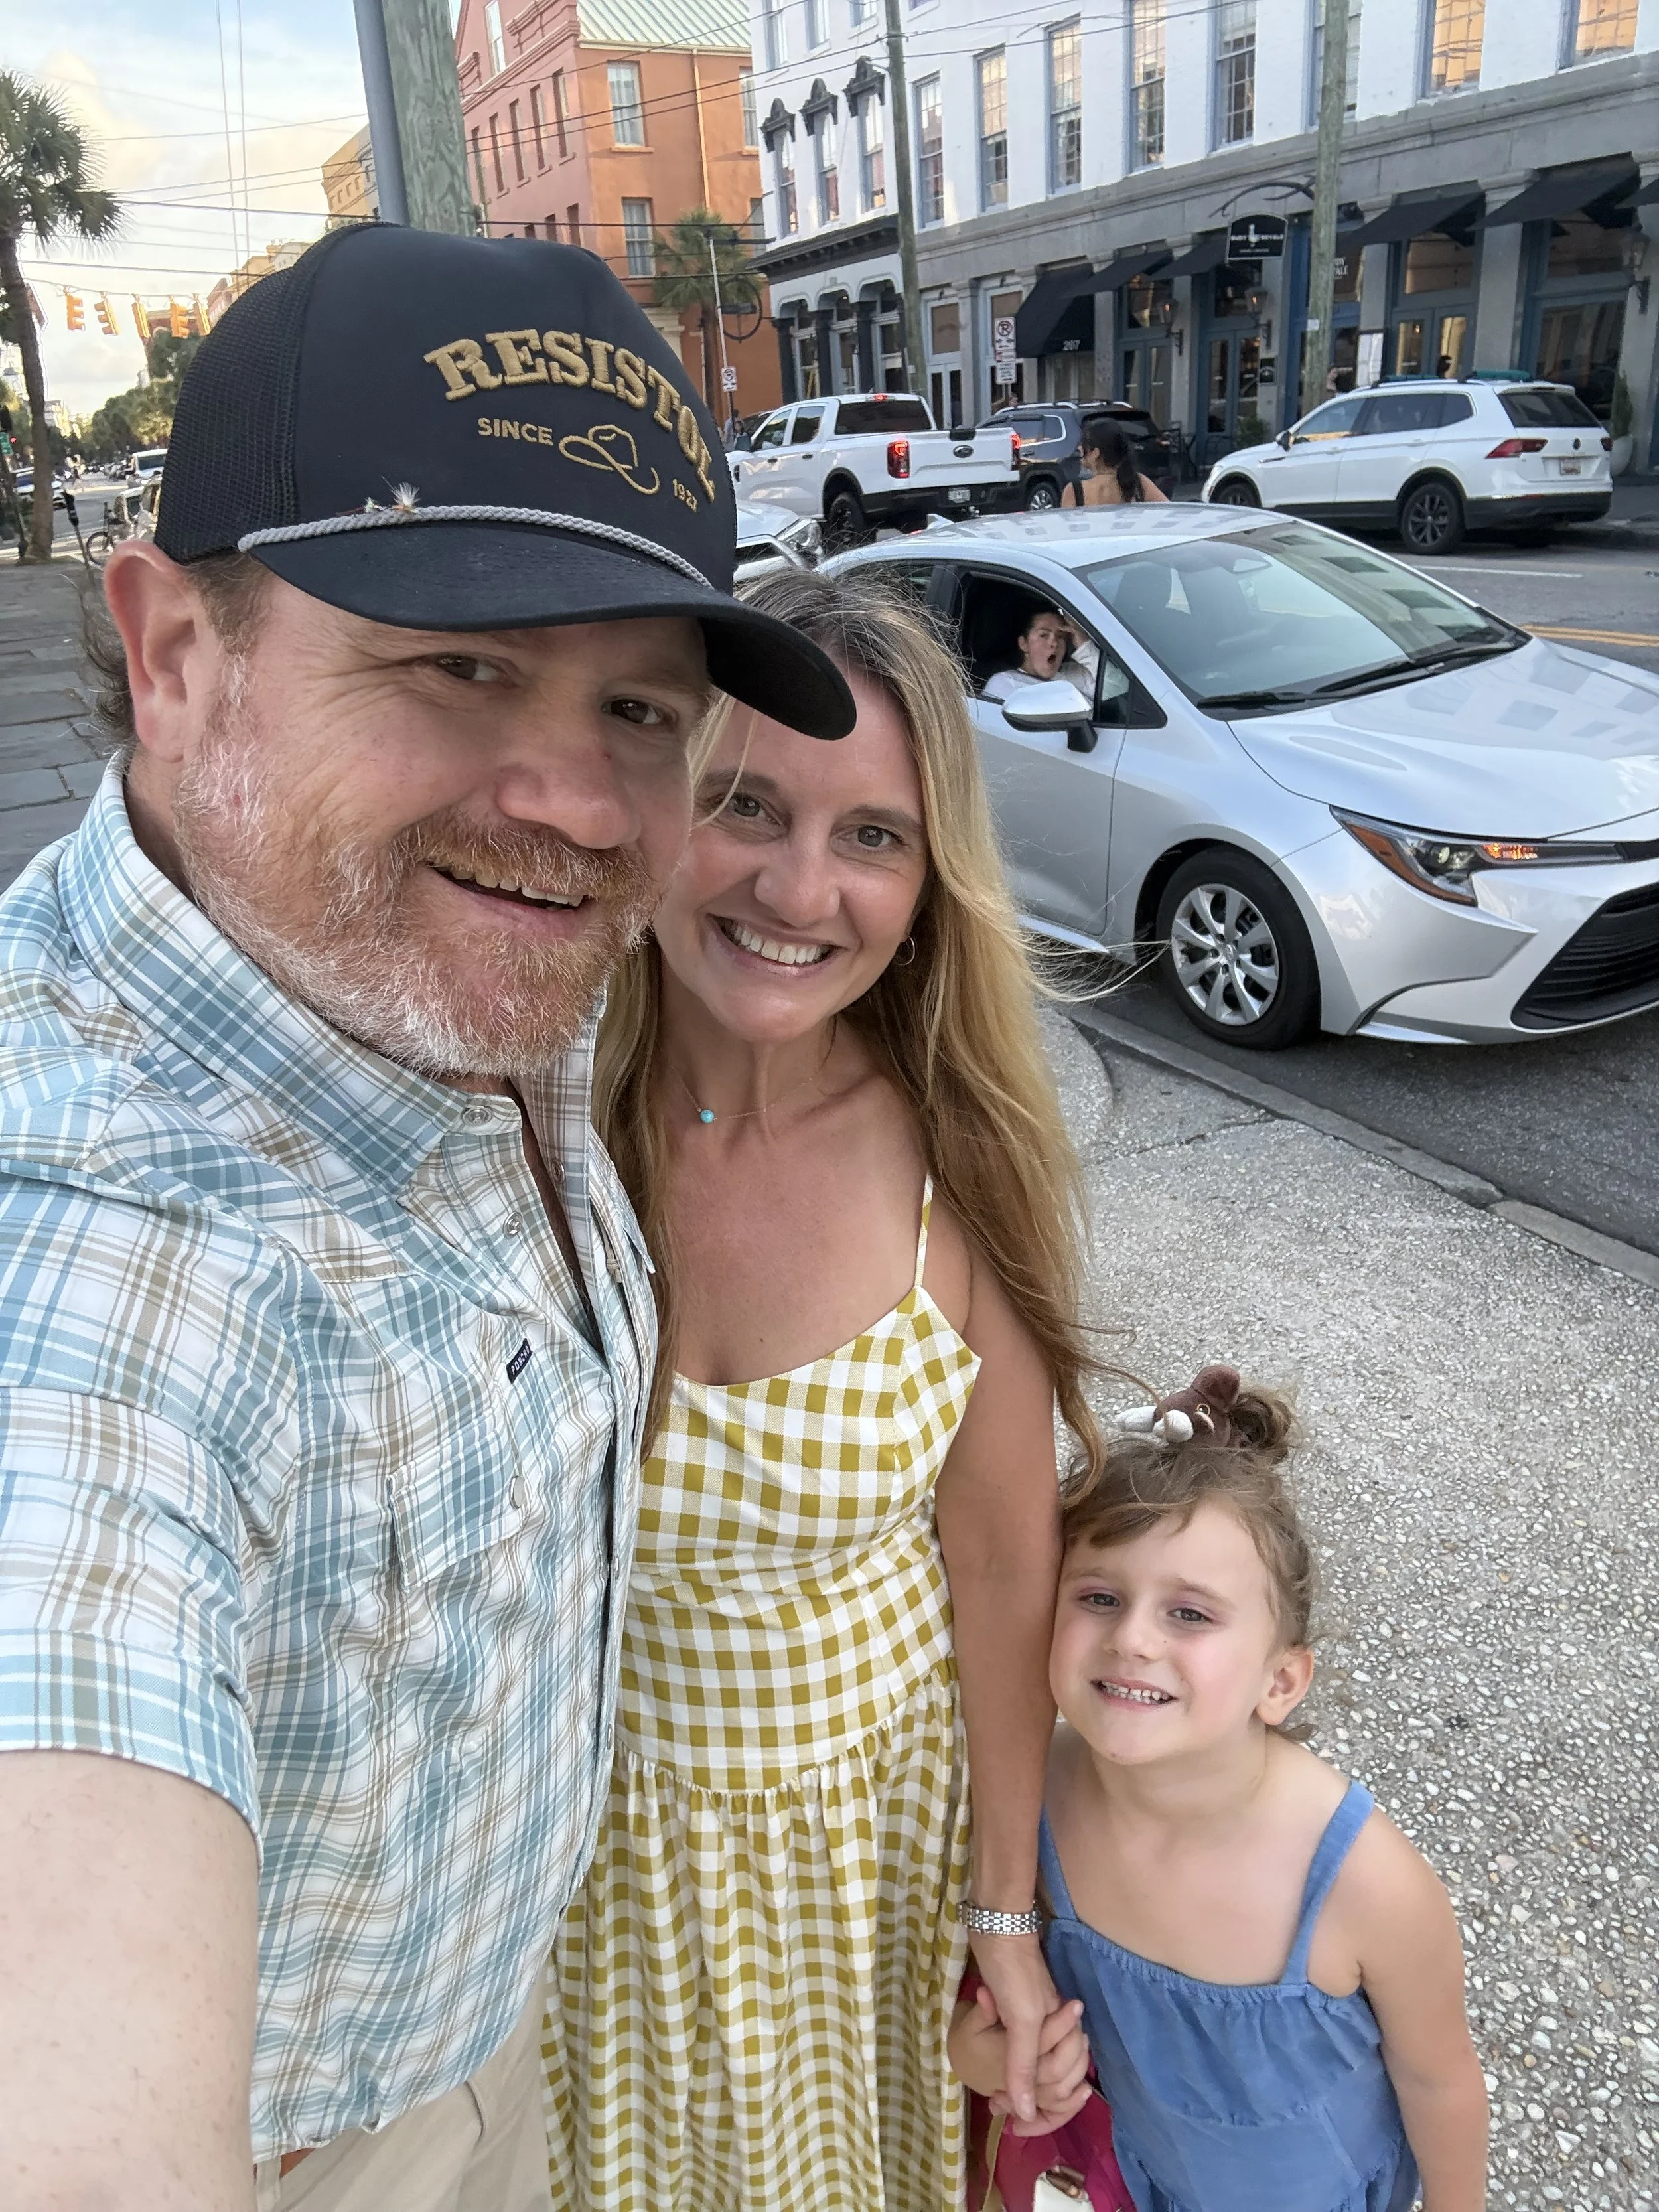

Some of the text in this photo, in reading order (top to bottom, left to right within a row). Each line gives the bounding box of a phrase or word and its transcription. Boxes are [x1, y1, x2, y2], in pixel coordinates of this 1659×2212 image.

[477, 417, 697, 512] SINCE 1927
[511, 1345, 530, 1376] PONCHO
